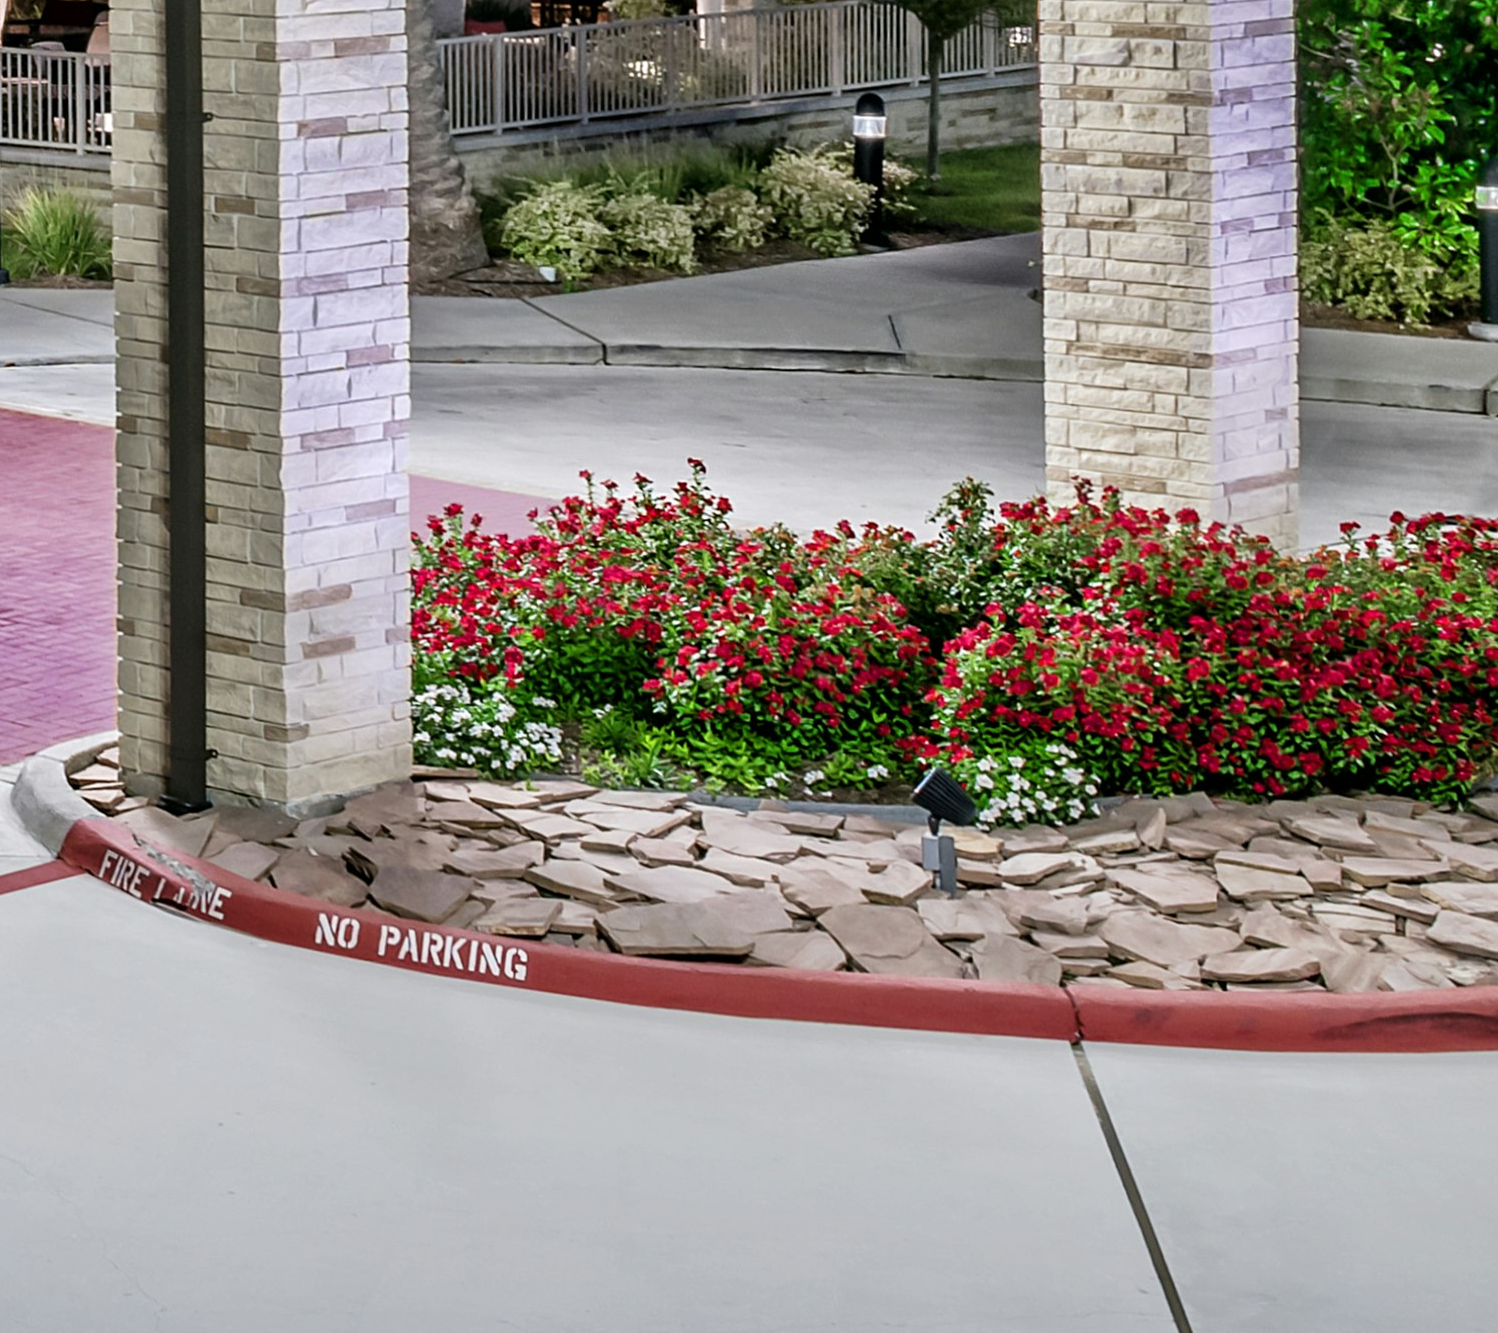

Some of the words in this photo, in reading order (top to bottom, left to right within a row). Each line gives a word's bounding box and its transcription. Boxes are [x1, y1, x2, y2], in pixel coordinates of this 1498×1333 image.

[98, 849, 150, 899] FIRE
[314, 913, 361, 950] NO
[377, 924, 529, 982] PARKING
